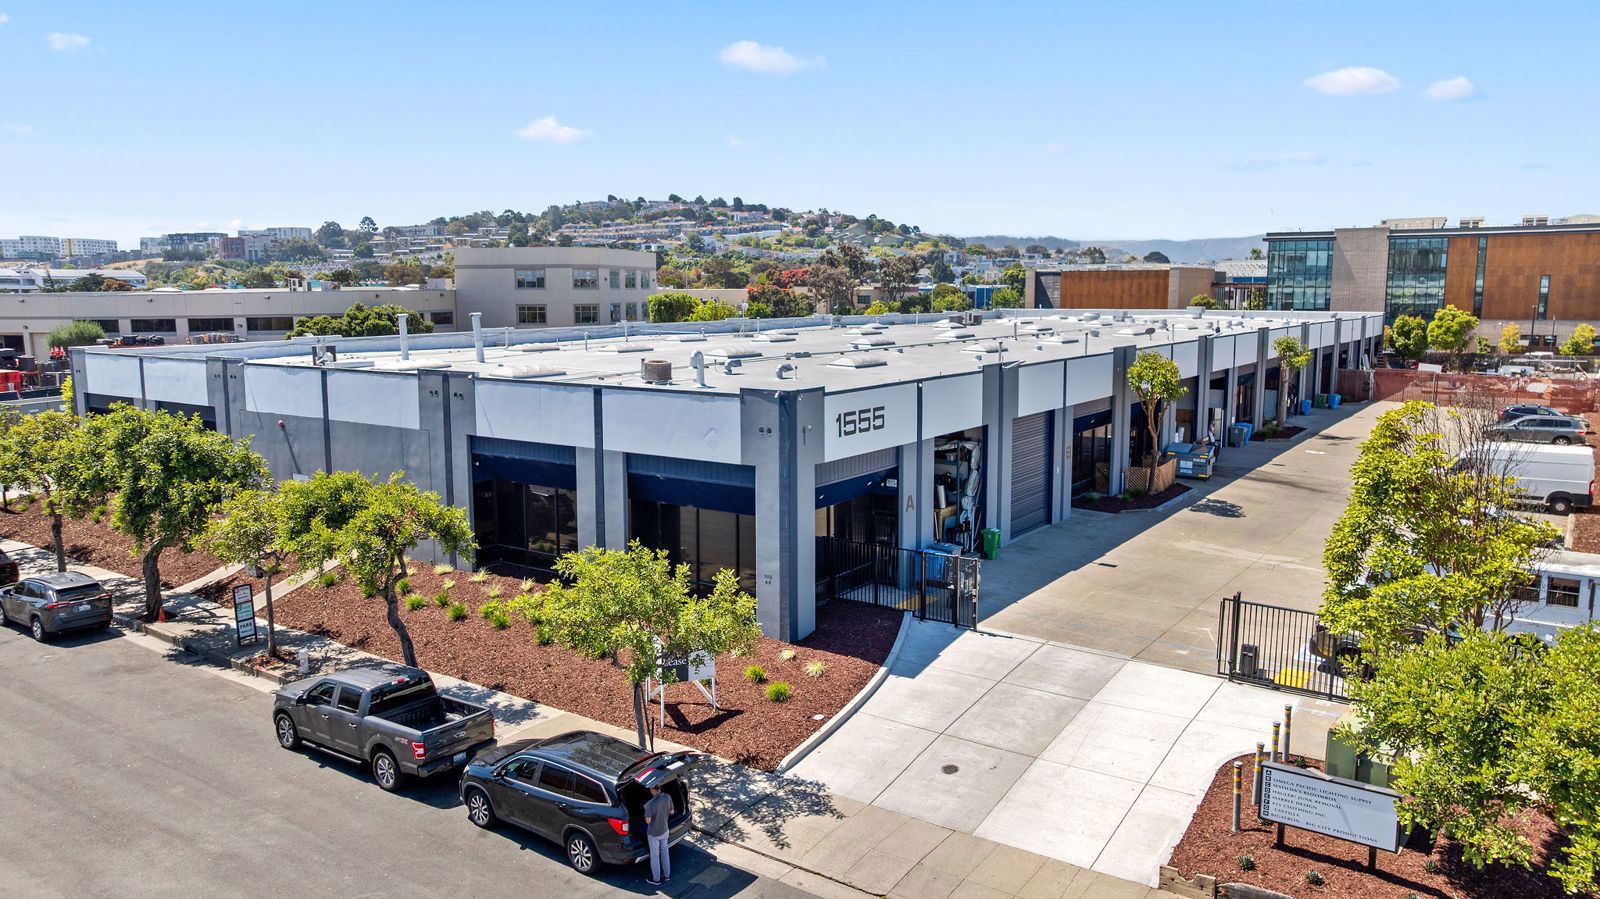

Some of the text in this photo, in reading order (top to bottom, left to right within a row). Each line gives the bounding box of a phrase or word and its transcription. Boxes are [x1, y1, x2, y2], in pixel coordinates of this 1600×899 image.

[836, 406, 885, 438] 1555
[905, 495, 914, 512] A
[1273, 778, 1373, 805] OMEGA PACIFIC LIGHTING SUPPLY
[1303, 791, 1337, 801] BLOOMBOX
[1295, 801, 1318, 809] DESIGN
[1314, 800, 1342, 809] REMOVAL
[1332, 828, 1378, 843] PRODUCTIONS
